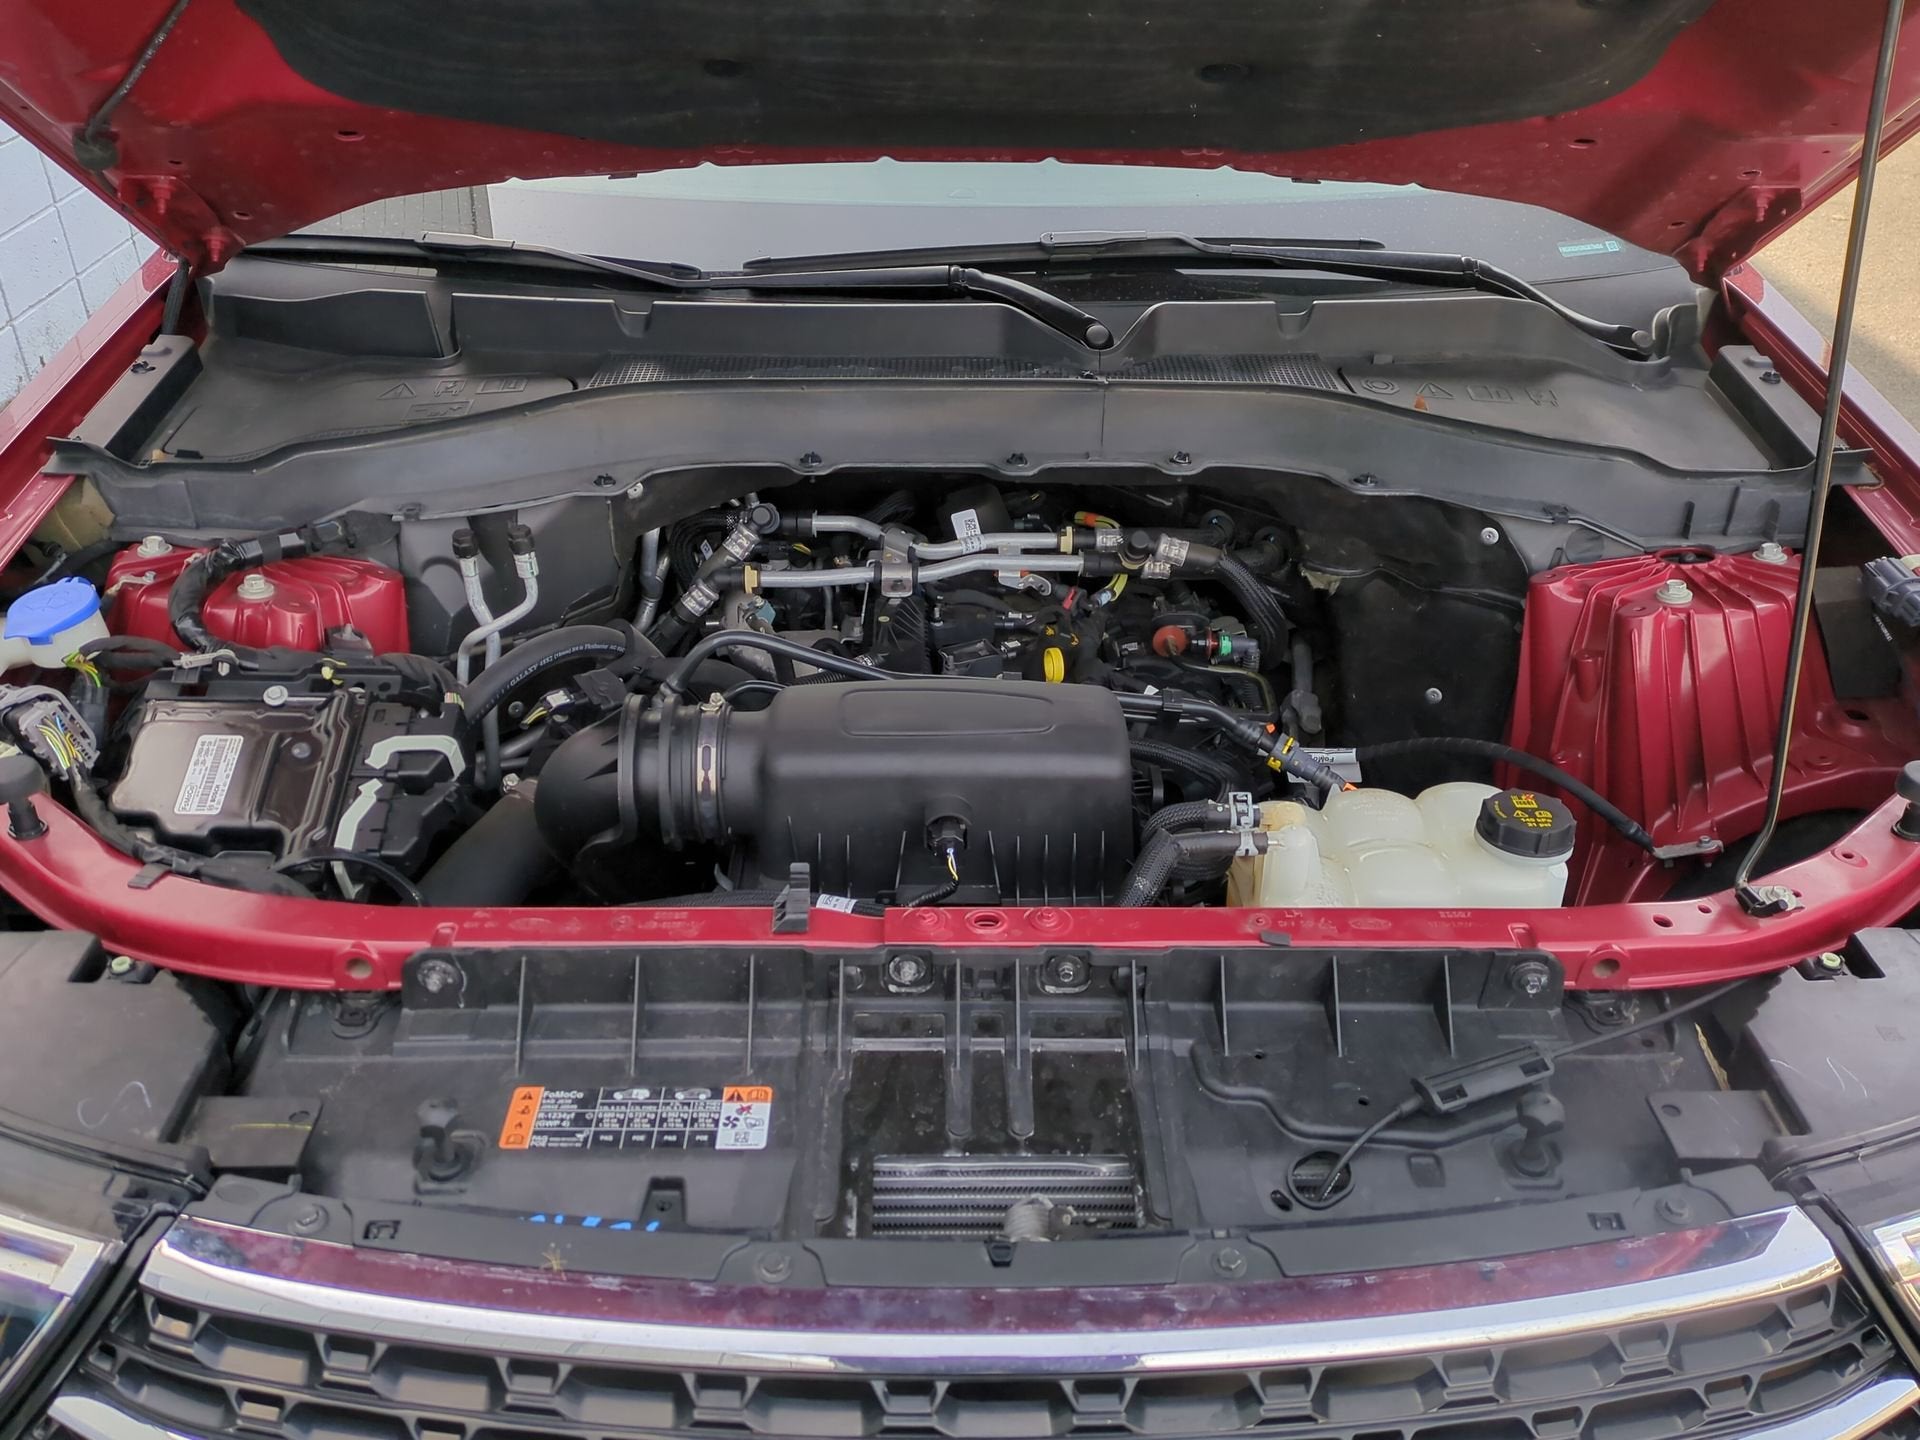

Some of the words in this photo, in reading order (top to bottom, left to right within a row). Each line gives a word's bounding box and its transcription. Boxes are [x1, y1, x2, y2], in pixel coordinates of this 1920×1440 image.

[510, 664, 538, 686] GALAXY
[181, 784, 195, 811] FoMoCo
[211, 785, 220, 803] BOSCH
[543, 1090, 584, 1100] FoMoCo
[538, 1112, 576, 1121] R-1234yf
